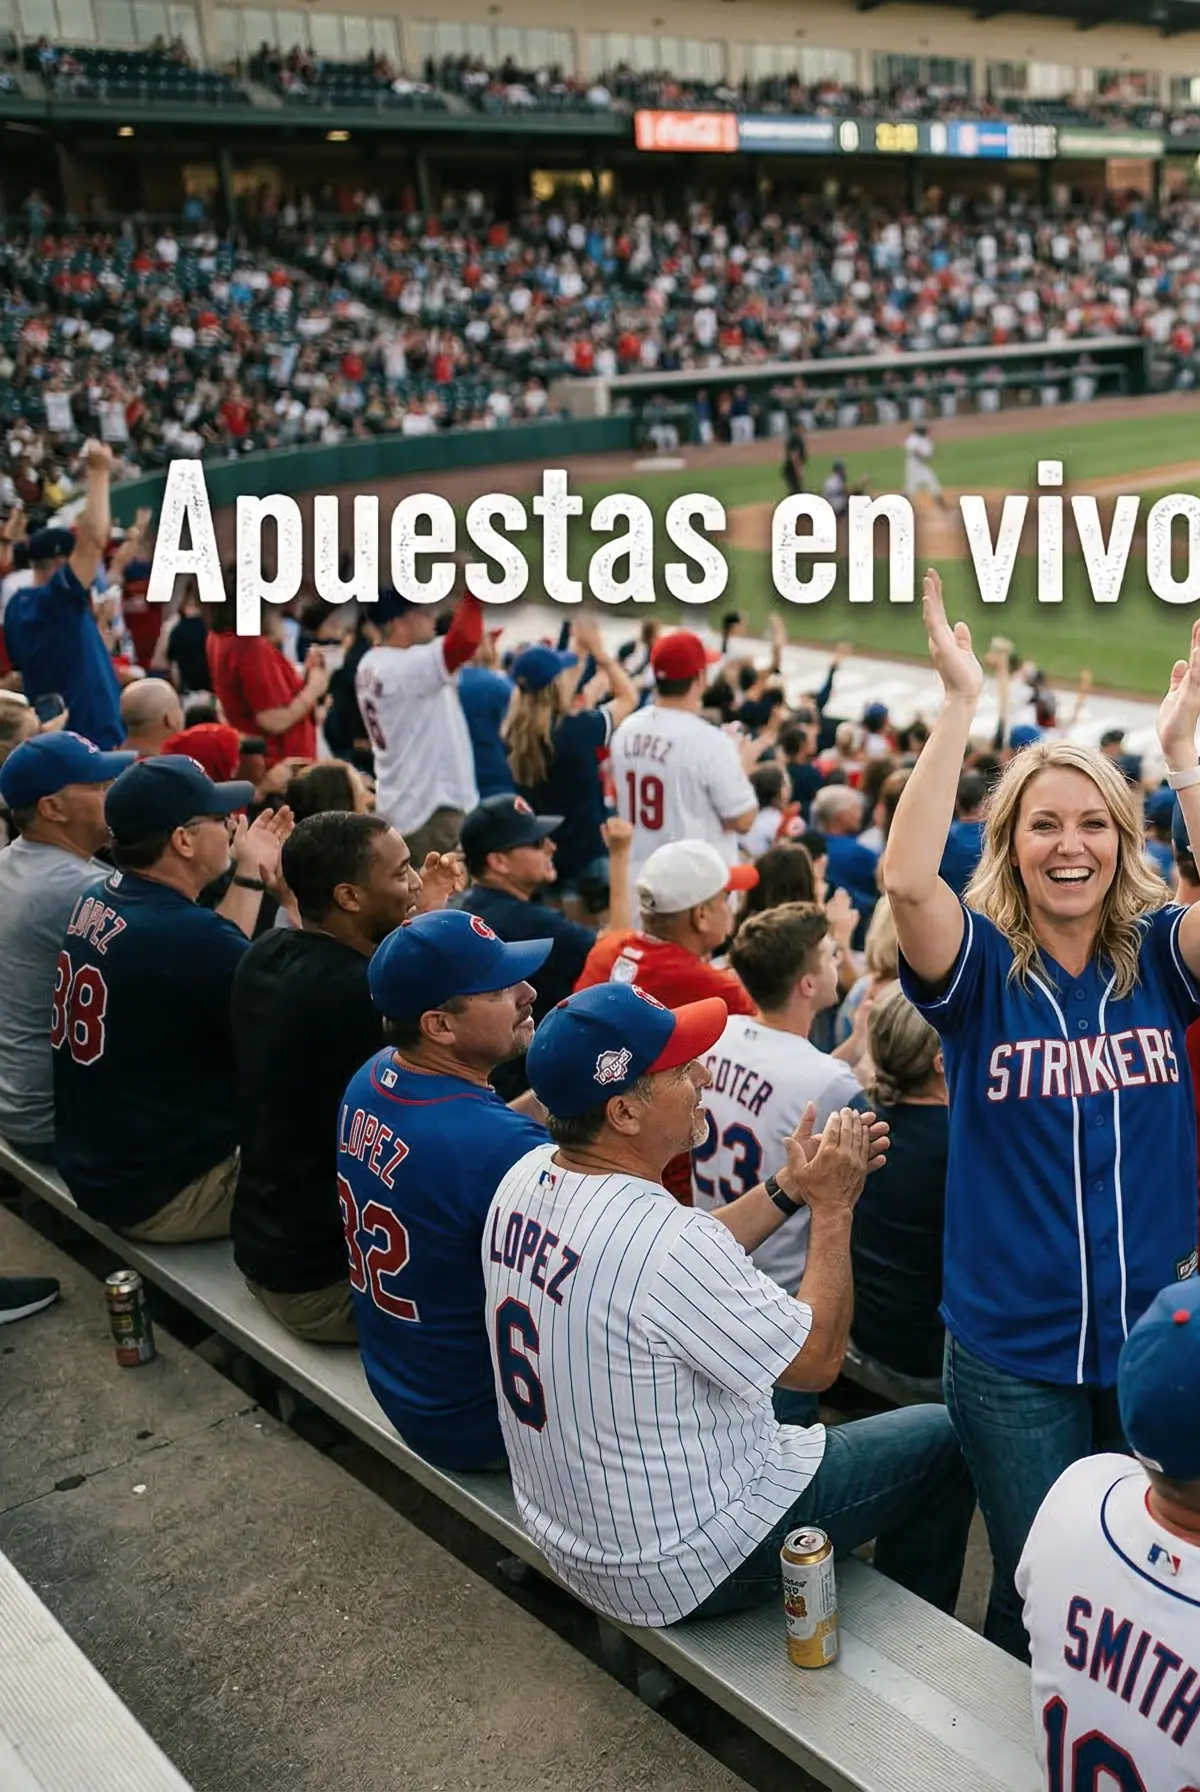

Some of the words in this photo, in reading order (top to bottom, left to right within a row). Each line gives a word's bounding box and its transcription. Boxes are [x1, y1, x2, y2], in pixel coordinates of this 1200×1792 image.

[623, 733, 673, 765] LOPEZ
[626, 771, 664, 830] 19
[67, 895, 127, 956] LOPEZ
[986, 1027, 1180, 1102] STRIKERS
[338, 1104, 410, 1190] LOPEZ
[691, 1107, 764, 1204] 23
[490, 1206, 581, 1306] LOPEZ
[496, 1295, 548, 1433] 6
